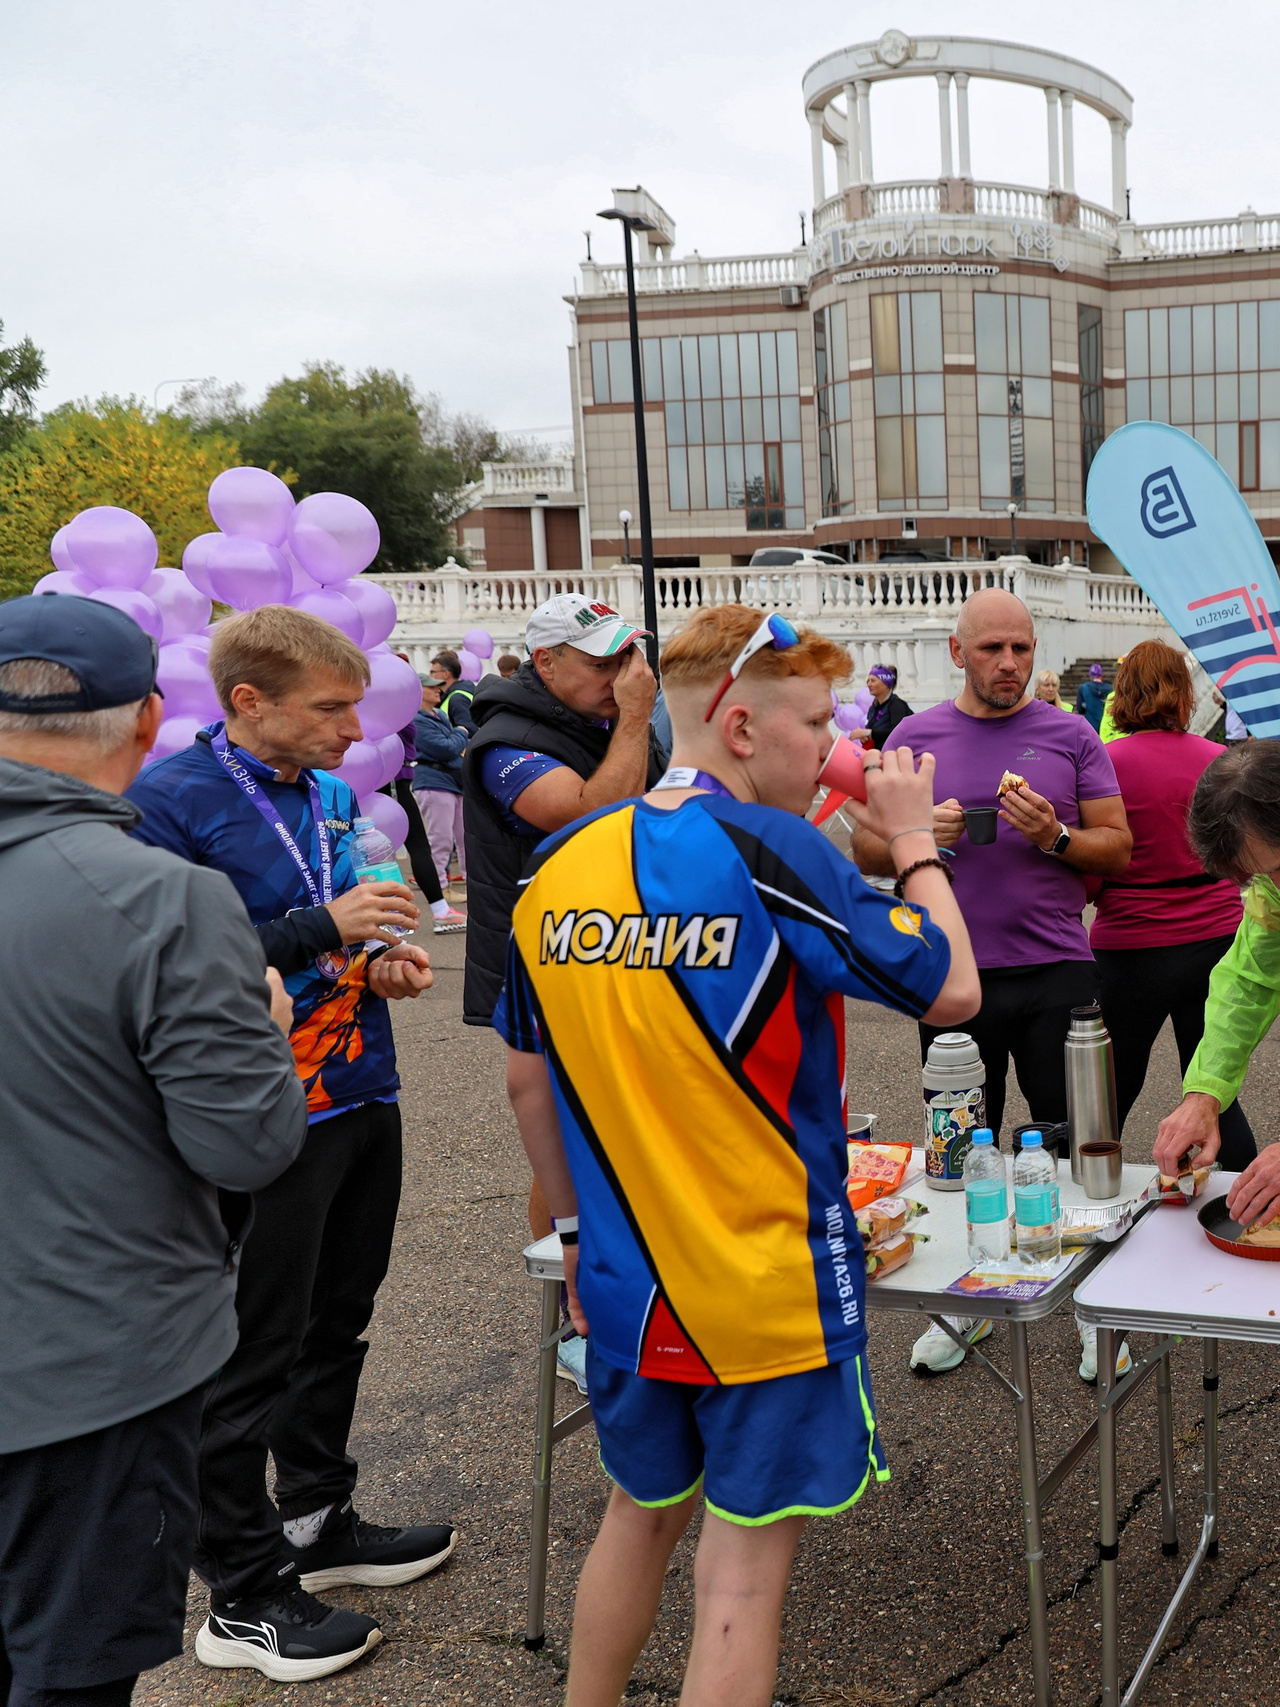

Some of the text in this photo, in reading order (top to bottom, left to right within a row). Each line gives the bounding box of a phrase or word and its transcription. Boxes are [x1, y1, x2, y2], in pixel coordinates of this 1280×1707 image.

[961, 264, 1000, 277] ЦЕНТР
[218, 747, 258, 795] ЖИЗНЬ
[499, 753, 528, 779] VOLGA
[274, 822, 308, 871] ФИОЛЕТОВЫЙ
[302, 869, 317, 892] ЗАБЕГ
[317, 821, 333, 905] ОЛЕТОВЫЙ ЗАБЕГ 2026
[540, 908, 741, 969] МОЛНИЯ
[825, 1203, 860, 1326] MOLNIYA26.RU
